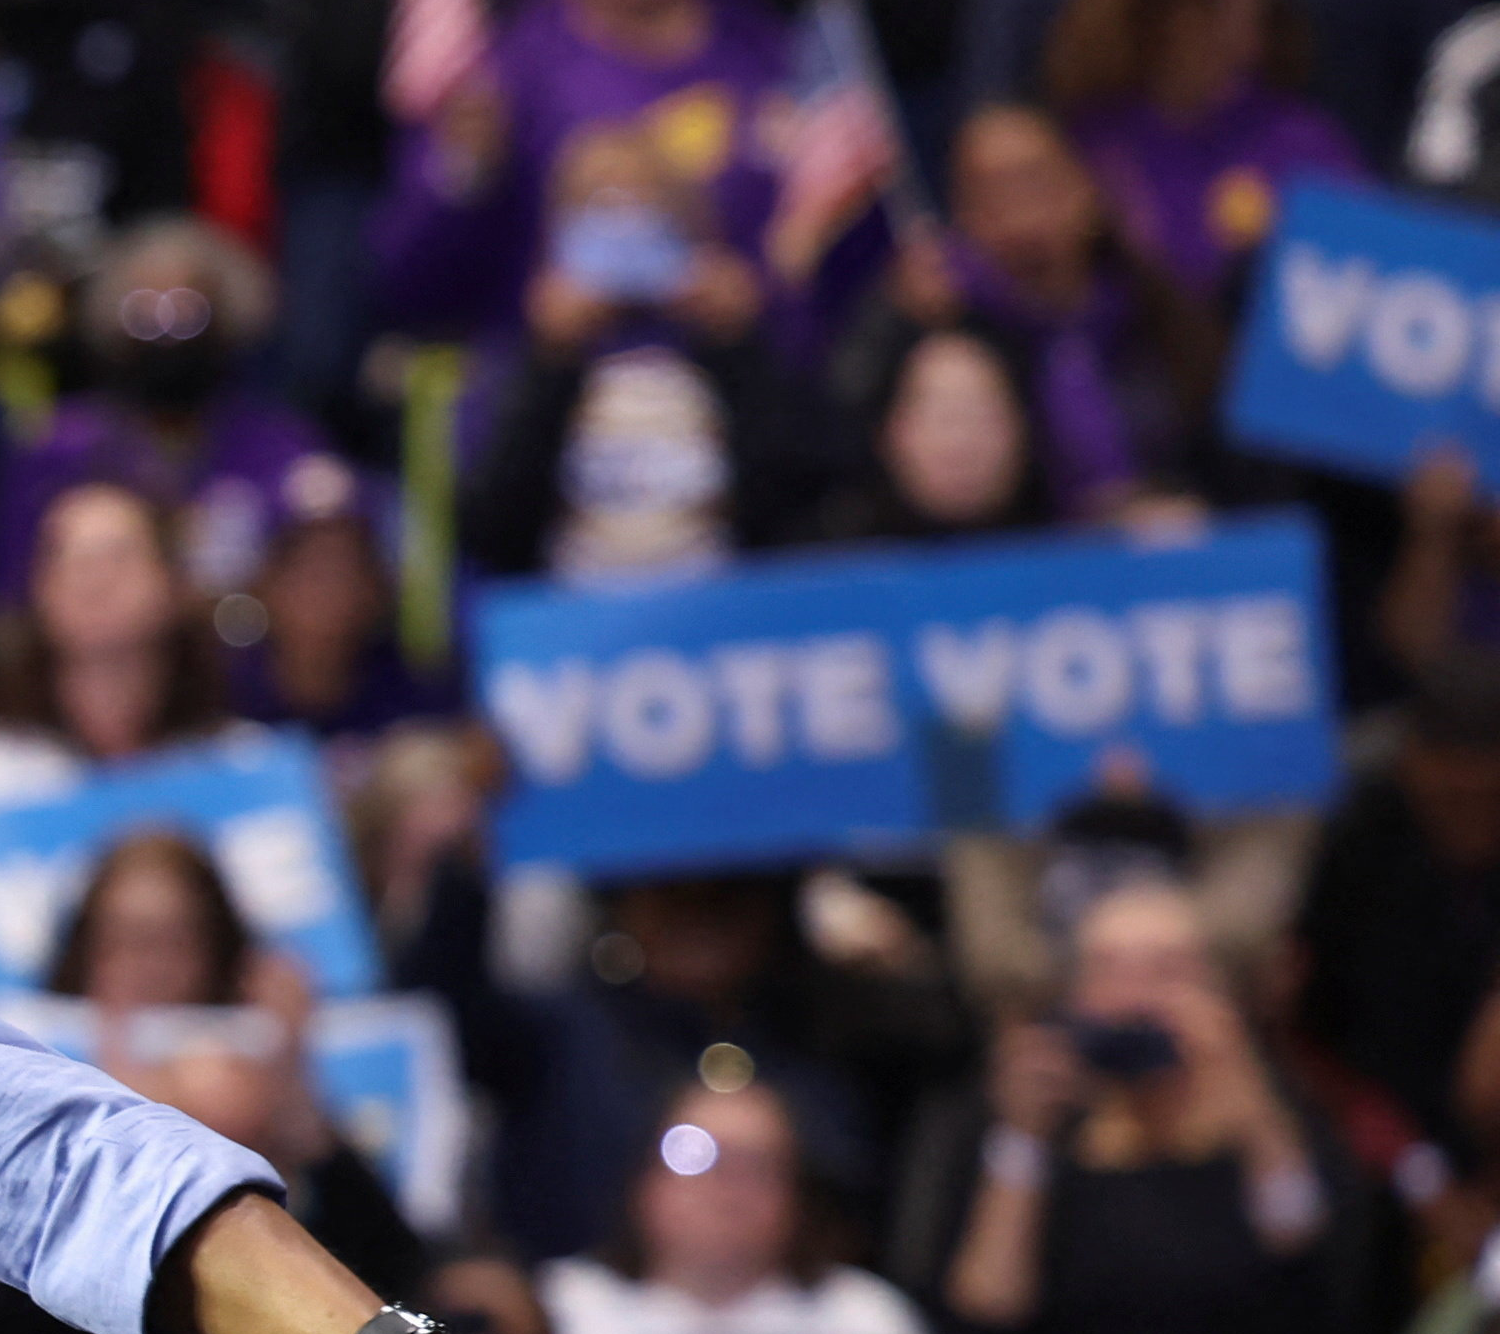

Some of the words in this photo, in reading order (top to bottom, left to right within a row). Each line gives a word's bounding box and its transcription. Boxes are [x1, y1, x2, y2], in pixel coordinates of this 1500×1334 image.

[1282, 242, 1500, 412] VO
[496, 633, 894, 783] VOTE
[920, 593, 1308, 735] VOTE
